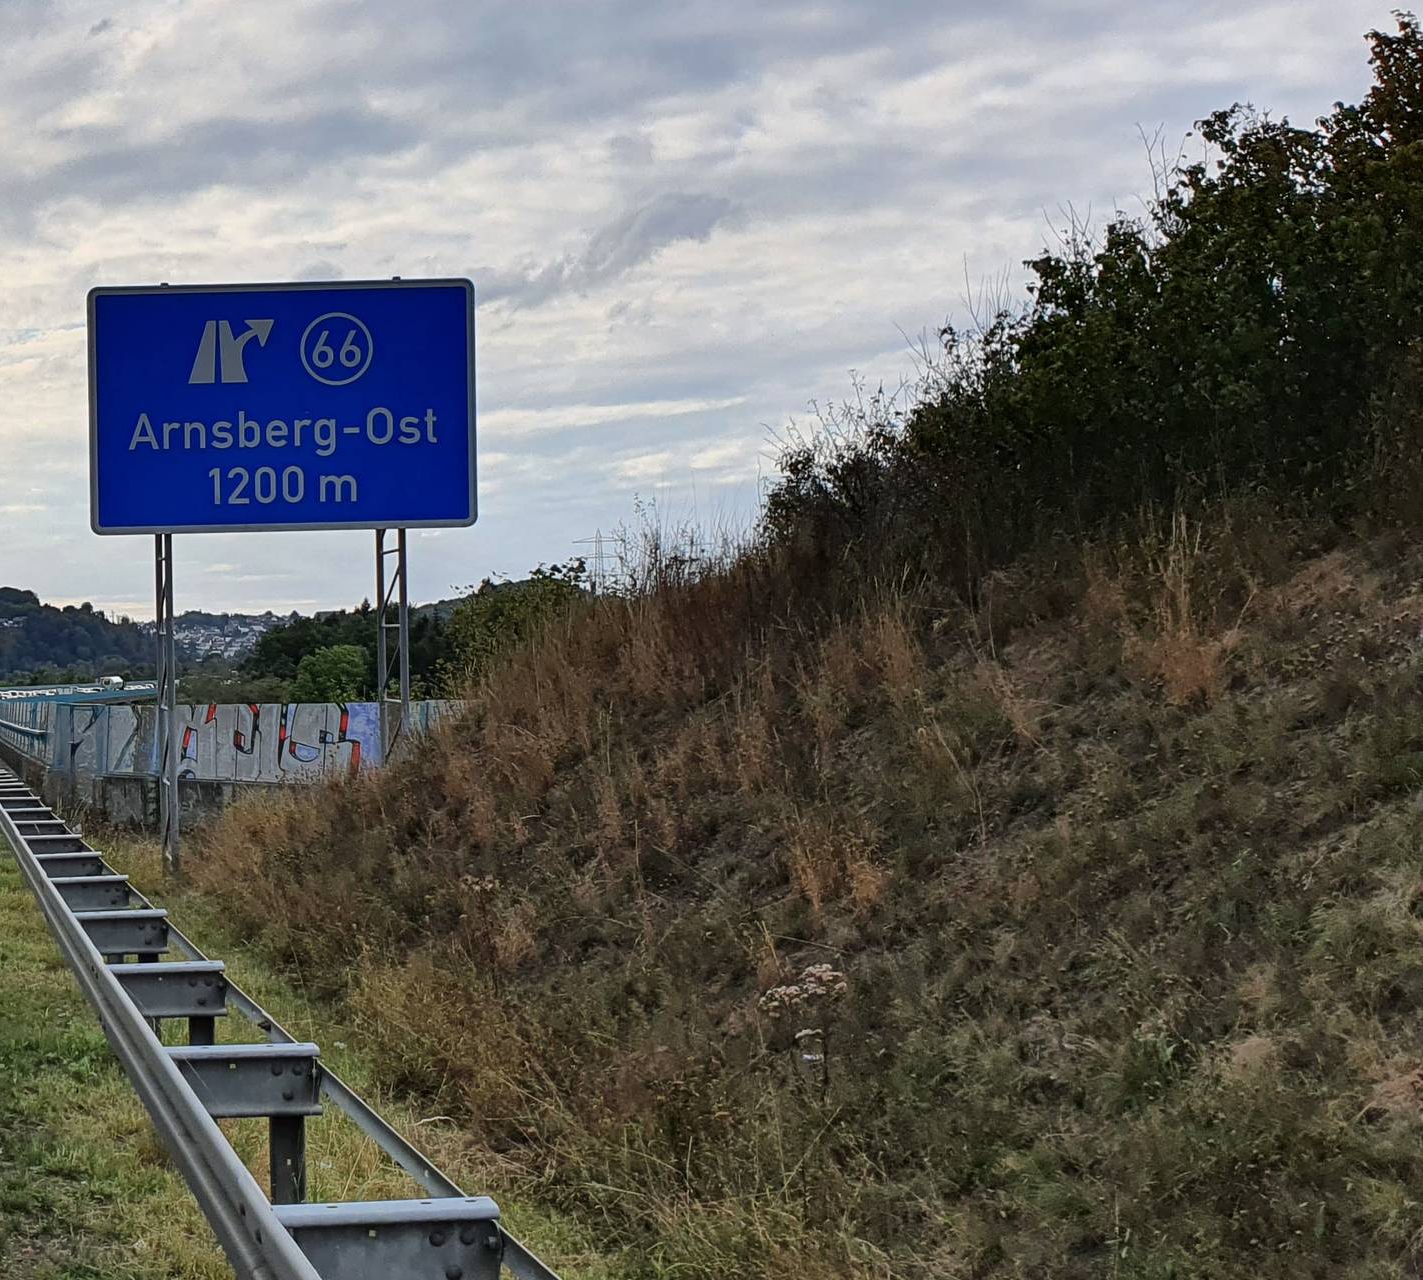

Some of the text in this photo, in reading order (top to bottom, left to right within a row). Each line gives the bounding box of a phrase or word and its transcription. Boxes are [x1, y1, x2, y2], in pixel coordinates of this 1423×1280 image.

[312, 329, 362, 369] 66
[128, 406, 438, 457] Arnsberg-Ost
[208, 465, 358, 505] 1200 m
